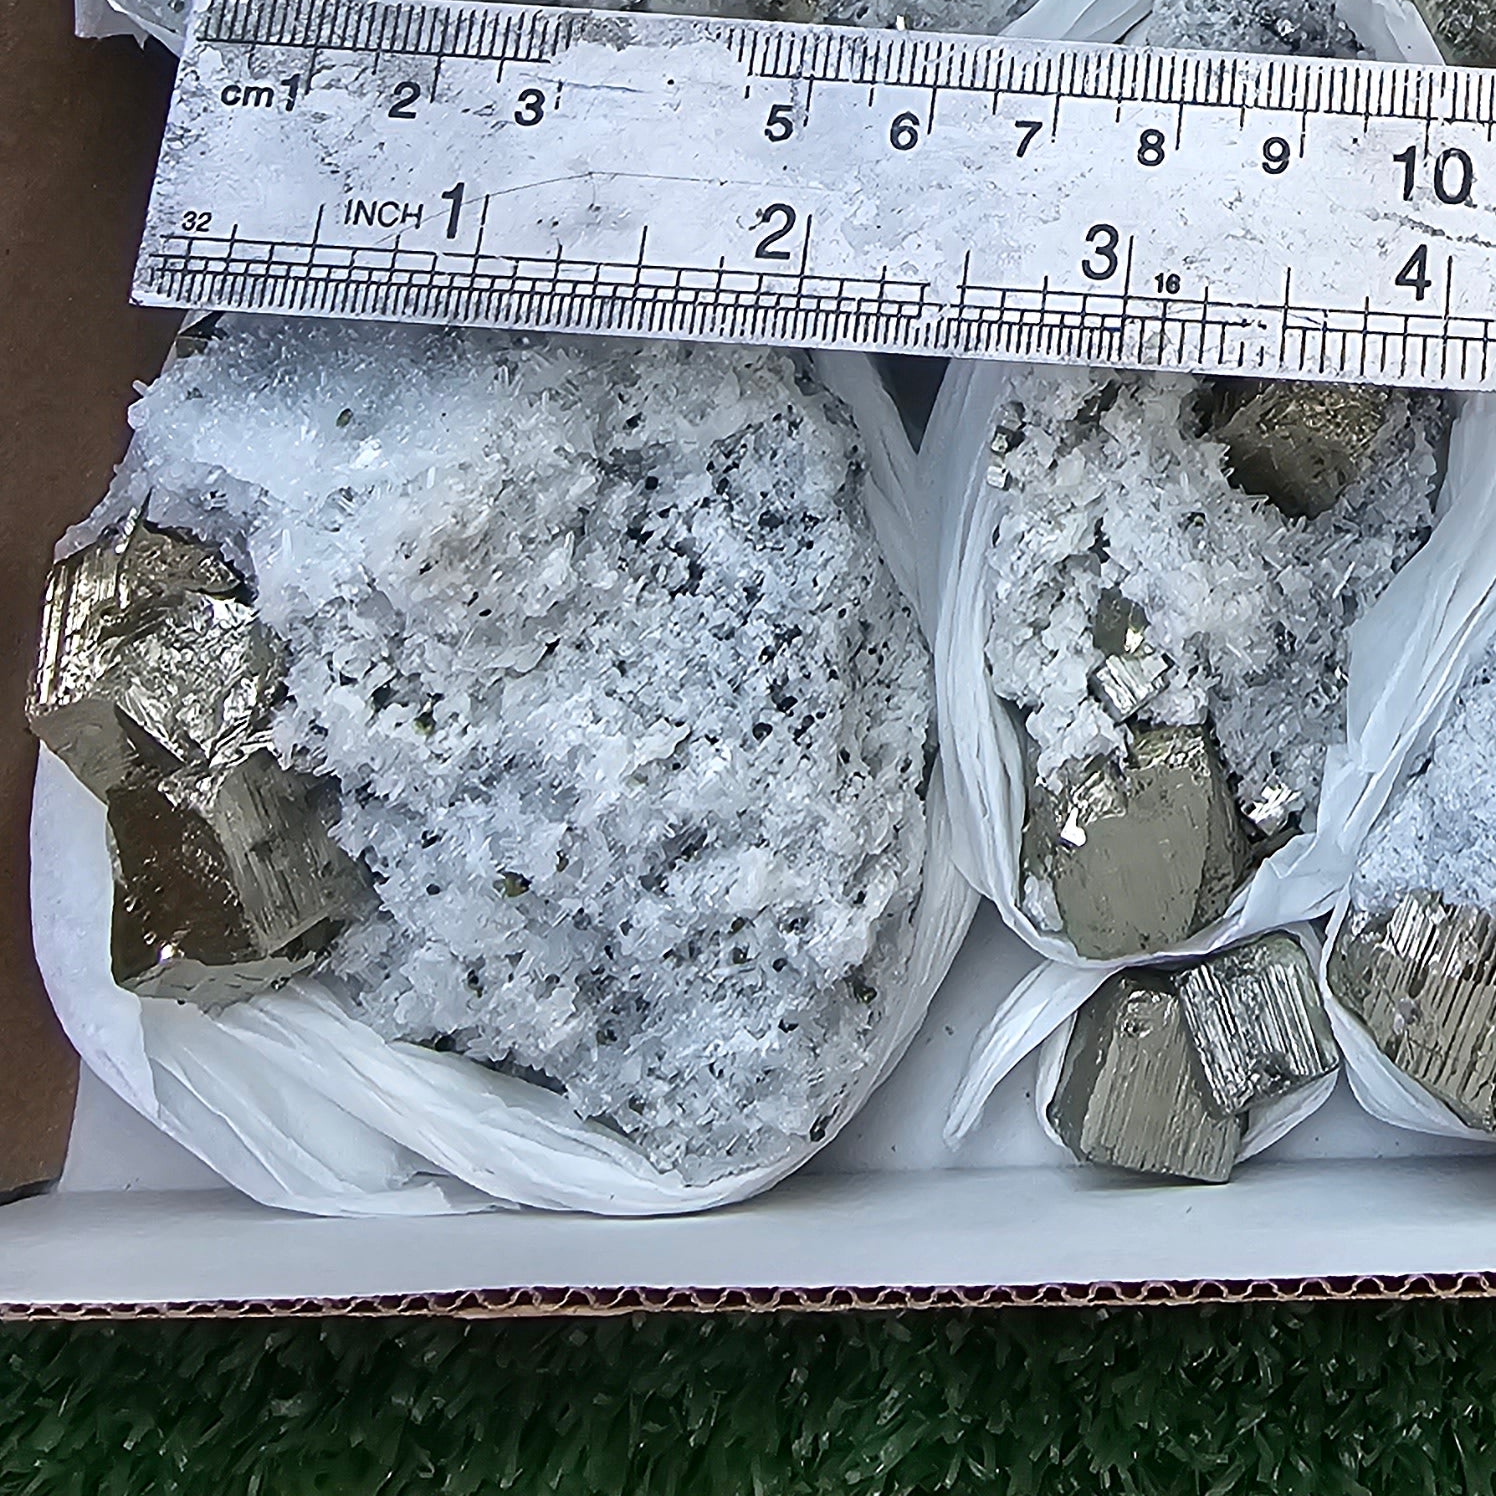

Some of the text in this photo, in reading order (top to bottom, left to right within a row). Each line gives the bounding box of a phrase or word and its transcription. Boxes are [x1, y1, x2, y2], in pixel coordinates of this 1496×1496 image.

[220, 83, 275, 109] cm
[280, 73, 300, 112] 1
[388, 82, 420, 120] 2
[514, 88, 545, 127] 3
[764, 106, 795, 143] 5
[889, 111, 921, 151] 6
[1014, 121, 1043, 159] 7
[1137, 129, 1167, 167] 8
[1261, 137, 1291, 175] 9
[1392, 146, 1475, 206] 10
[181, 212, 213, 233] 32
[344, 198, 424, 230] INCH
[441, 182, 467, 240] 1
[754, 203, 796, 260] 2
[1081, 223, 1119, 281] 3
[1394, 244, 1432, 302] 4
[1154, 273, 1181, 295] 16
